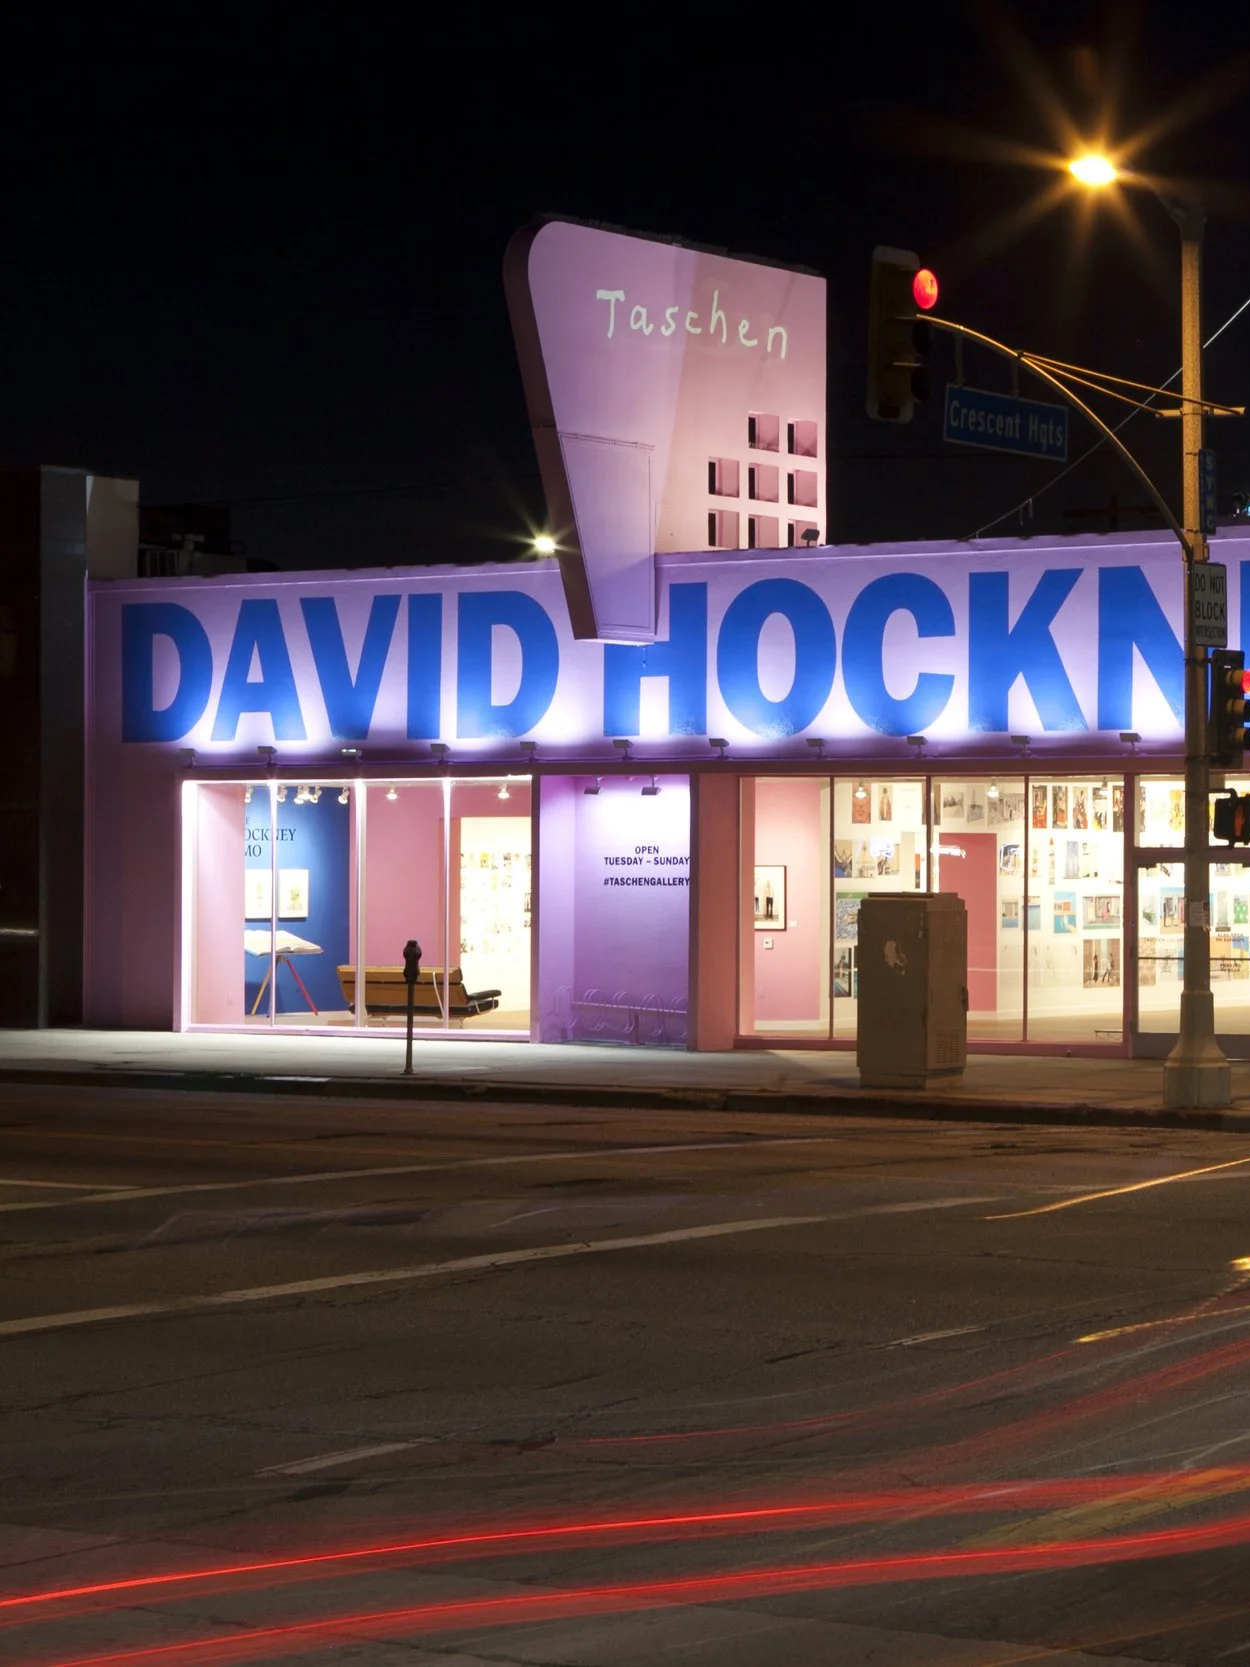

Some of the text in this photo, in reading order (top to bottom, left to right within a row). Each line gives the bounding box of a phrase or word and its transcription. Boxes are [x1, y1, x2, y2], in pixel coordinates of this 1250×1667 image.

[596, 289, 787, 359] Taschen
[949, 399, 1064, 453] Crescent Hgts
[1194, 573, 1225, 595] DO NOT
[1195, 600, 1226, 621] BLOCK
[122, 590, 560, 744] DAVID
[634, 845, 660, 855] OPEN
[604, 856, 644, 866] TUESDAY
[653, 856, 690, 866] SUNDAY
[603, 877, 691, 887] #TASCHENGALLERY
